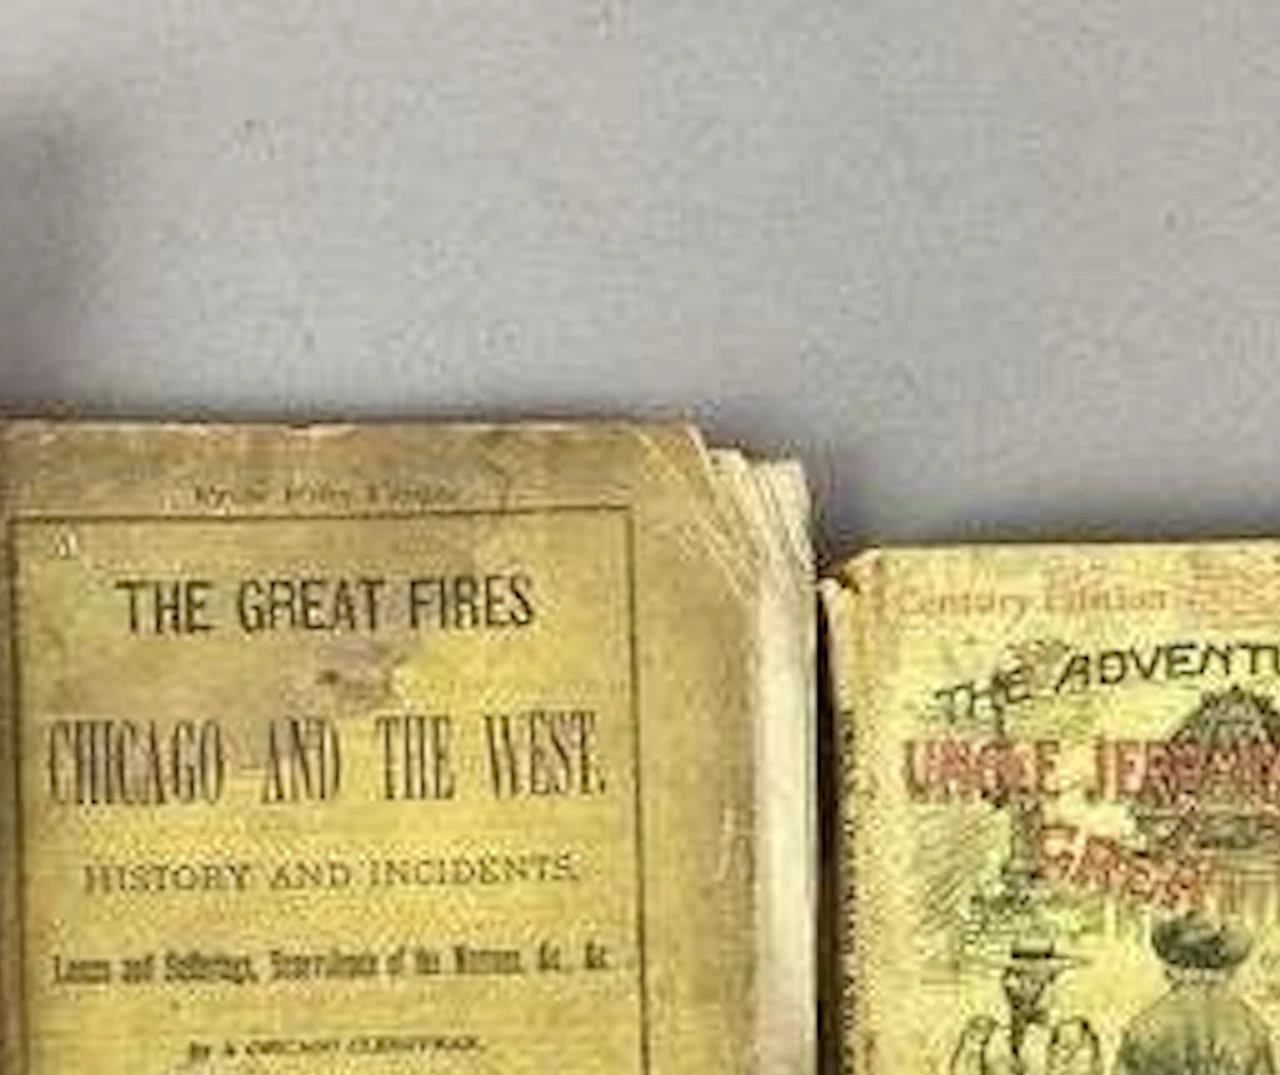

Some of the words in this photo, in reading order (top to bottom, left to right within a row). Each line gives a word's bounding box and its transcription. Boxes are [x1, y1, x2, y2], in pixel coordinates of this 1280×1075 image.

[116, 578, 215, 634] THE
[238, 577, 387, 633] GREAT
[406, 574, 536, 630] FIRES
[932, 667, 1034, 722] THE
[48, 715, 225, 806] CHICAGO
[261, 717, 342, 803] AND
[373, 714, 456, 801] THE
[484, 710, 608, 800] WEST.
[82, 858, 250, 897] HISTORY
[269, 856, 355, 892] AND
